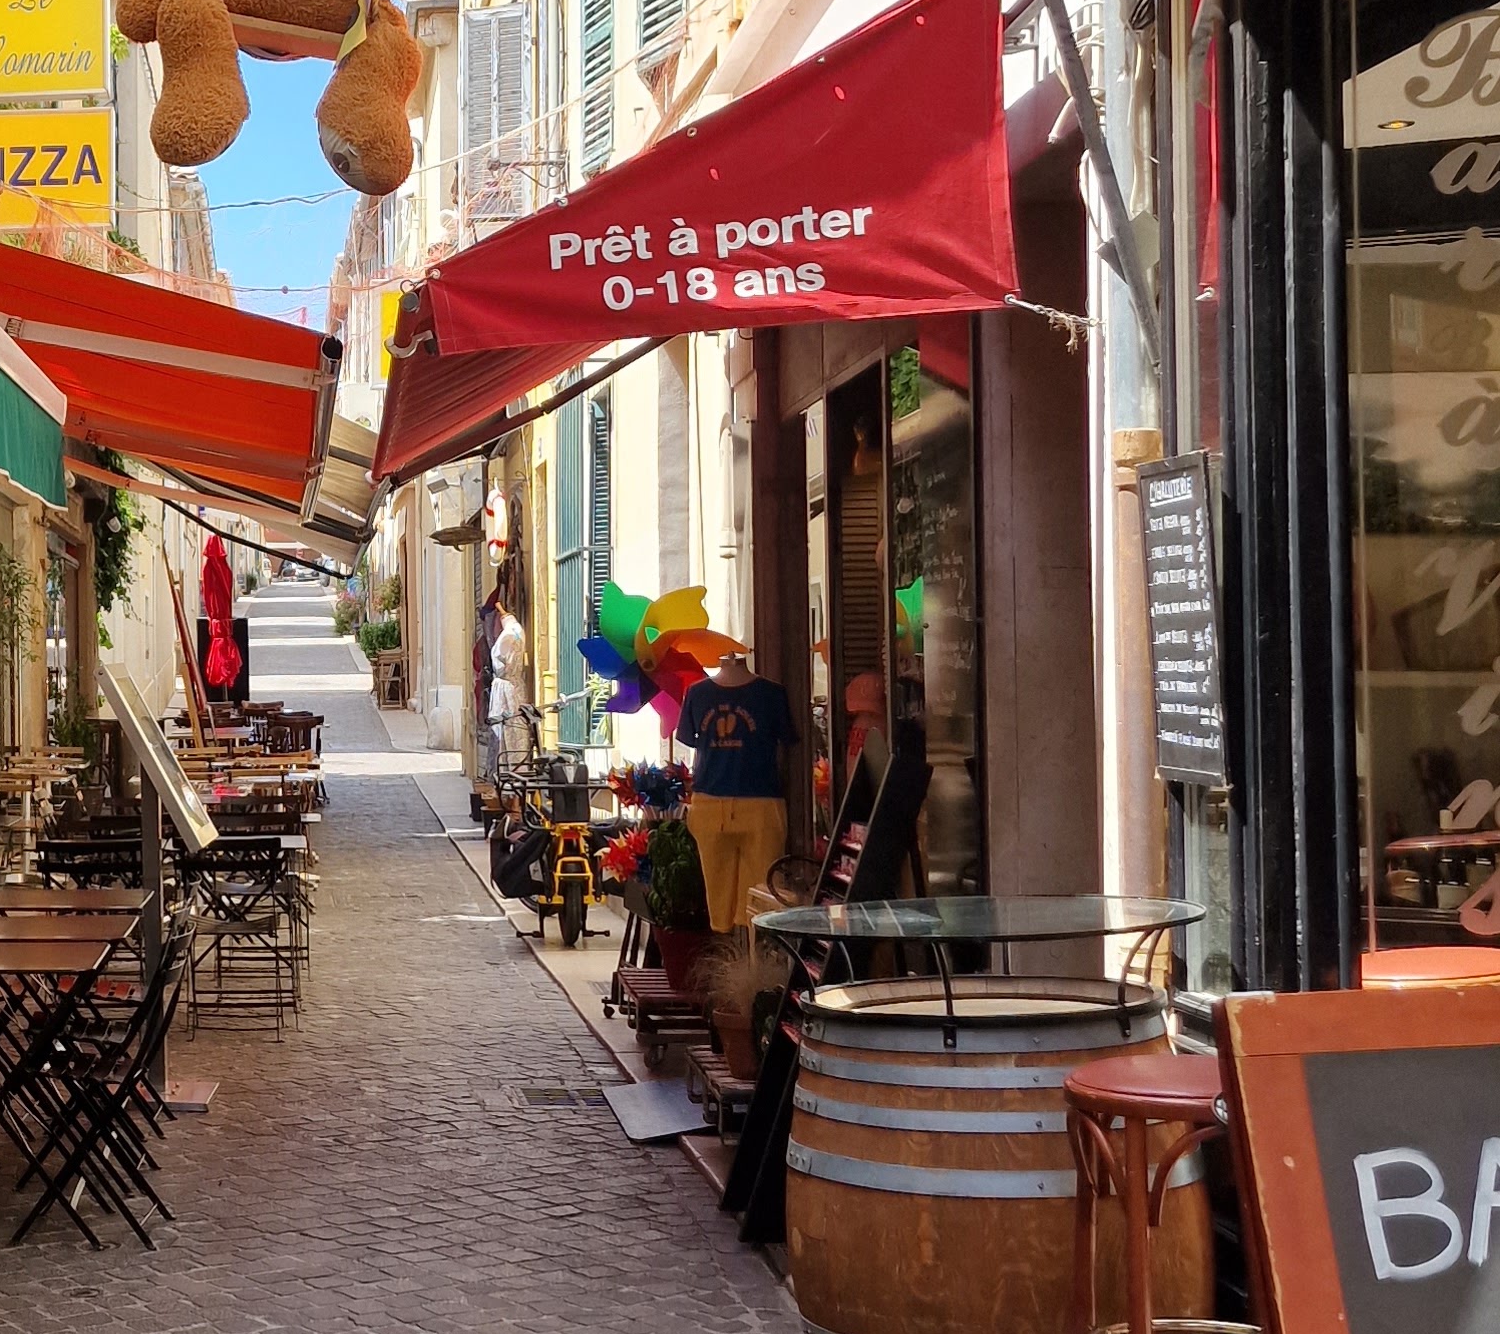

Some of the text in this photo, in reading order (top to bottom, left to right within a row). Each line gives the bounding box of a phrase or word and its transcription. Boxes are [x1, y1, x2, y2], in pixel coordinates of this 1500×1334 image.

[548, 205, 874, 270] Prêt à porter
[602, 261, 827, 311] 0-18 ans
